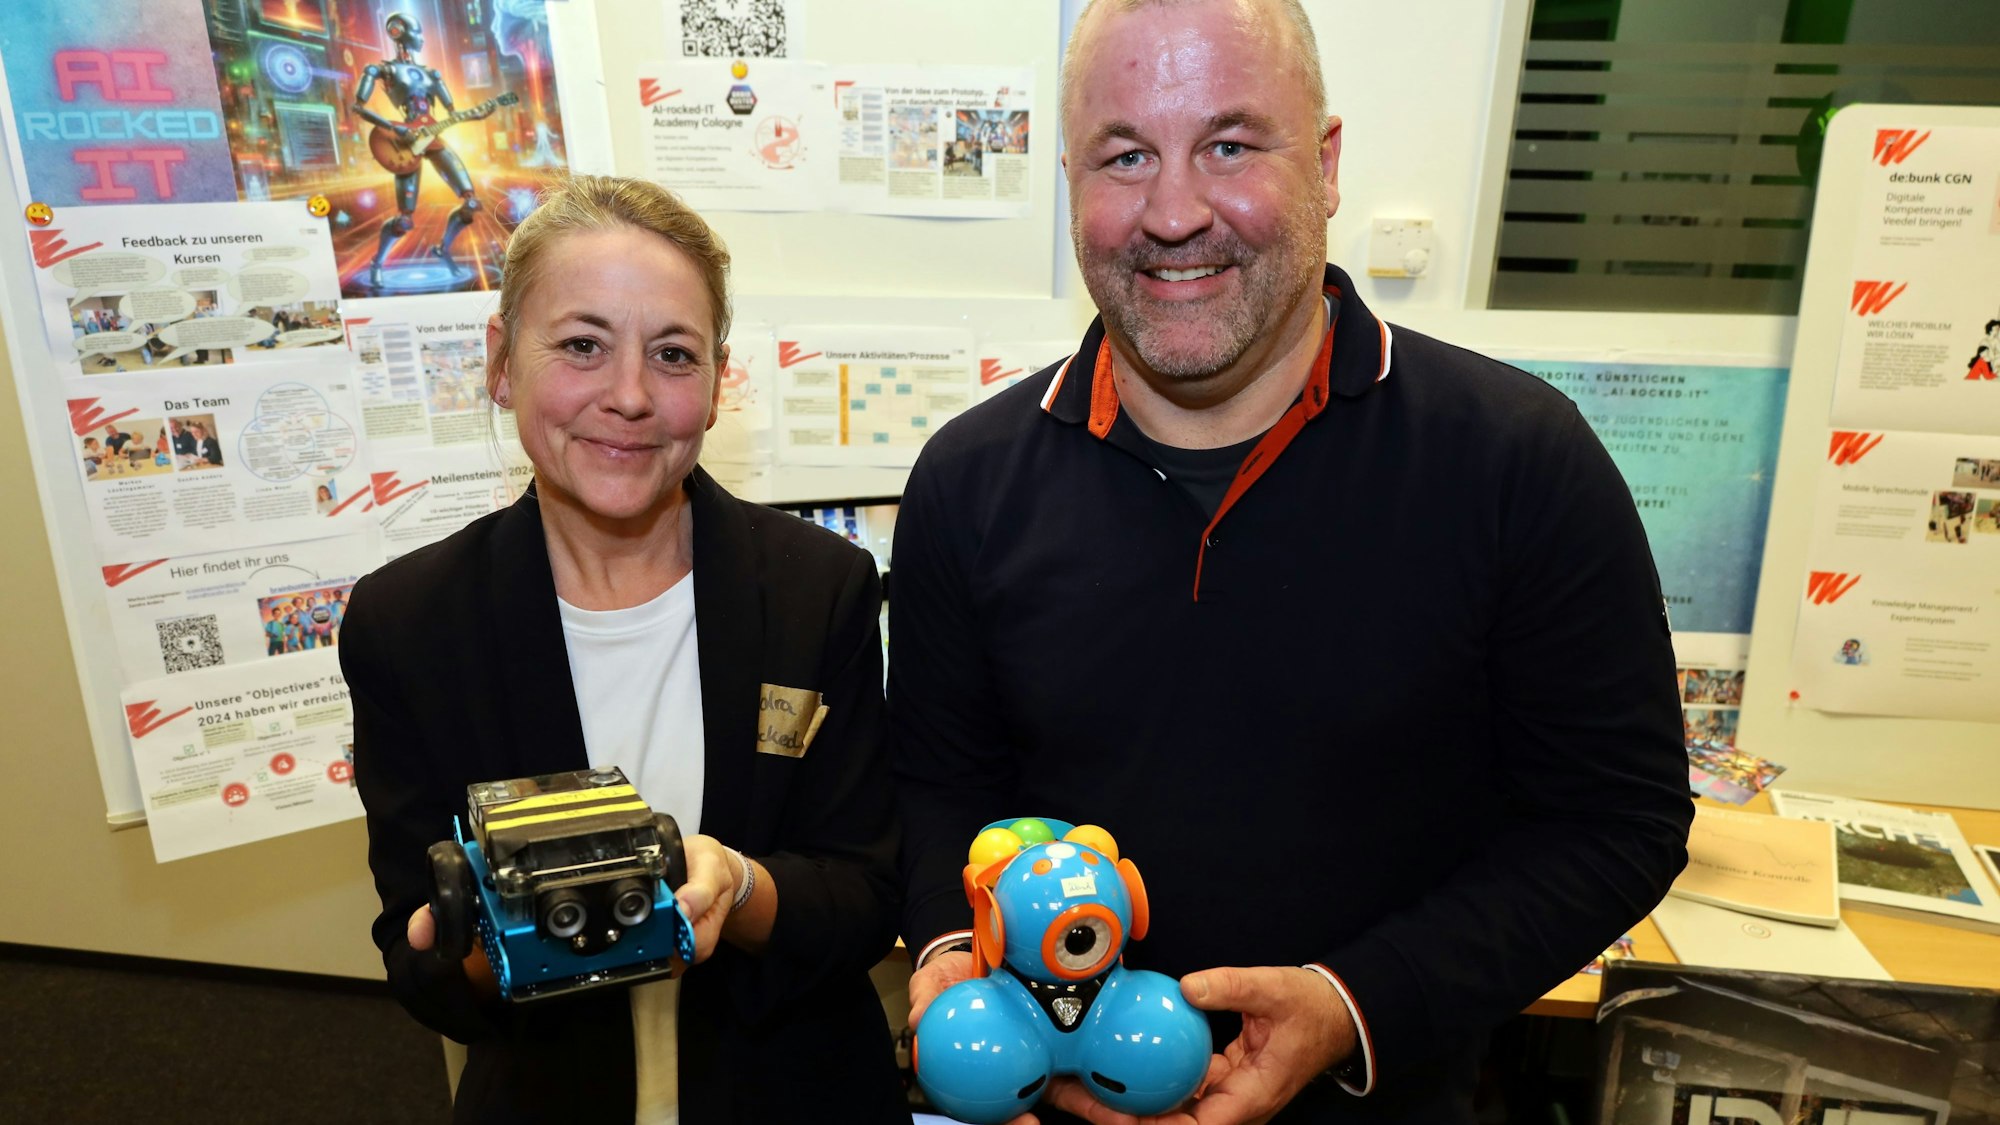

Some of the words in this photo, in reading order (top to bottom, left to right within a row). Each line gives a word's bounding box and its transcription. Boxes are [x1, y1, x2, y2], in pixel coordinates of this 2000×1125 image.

[54, 48, 174, 101] AI
[652, 104, 714, 115] AI-rocked-IT
[22, 109, 220, 143] ROCKED
[653, 117, 699, 129] Academy
[701, 117, 743, 129] Cologne
[73, 148, 185, 200] IT
[1889, 172, 1941, 183] de:bunk
[1944, 173, 1973, 184] CGN
[1886, 192, 1925, 203] Digitale
[1884, 205, 1942, 216] Kompetenz
[1957, 206, 1973, 216] die
[1883, 216, 1917, 227] Veedel
[1918, 217, 1962, 229] bringen!
[122, 234, 189, 249] Feedback
[192, 237, 208, 246] zu
[210, 232, 264, 246] unseren
[173, 252, 222, 266] Kursen
[416, 324, 435, 335] Von
[437, 323, 453, 333] der
[455, 322, 476, 332] Idee
[826, 351, 857, 361] Unsere
[859, 350, 951, 362] Aktivitäten/Prozesse
[1596, 371, 1686, 384] KÜNSTLICHEN
[164, 399, 190, 412] Das
[193, 396, 231, 408] Team
[1714, 418, 1729, 427] IM
[1668, 432, 1694, 442] UND
[1699, 433, 1746, 443] EIGENE
[431, 469, 503, 485] Meilensteine
[508, 466, 535, 477] 2024
[170, 566, 199, 579] Hier
[202, 559, 242, 574] findet
[244, 557, 261, 569] ihr
[266, 553, 290, 566] uns
[194, 694, 243, 711] Unsere
[329, 674, 347, 687] fü
[197, 712, 232, 728] 2024
[234, 705, 276, 719] haben
[279, 700, 299, 712] wir
